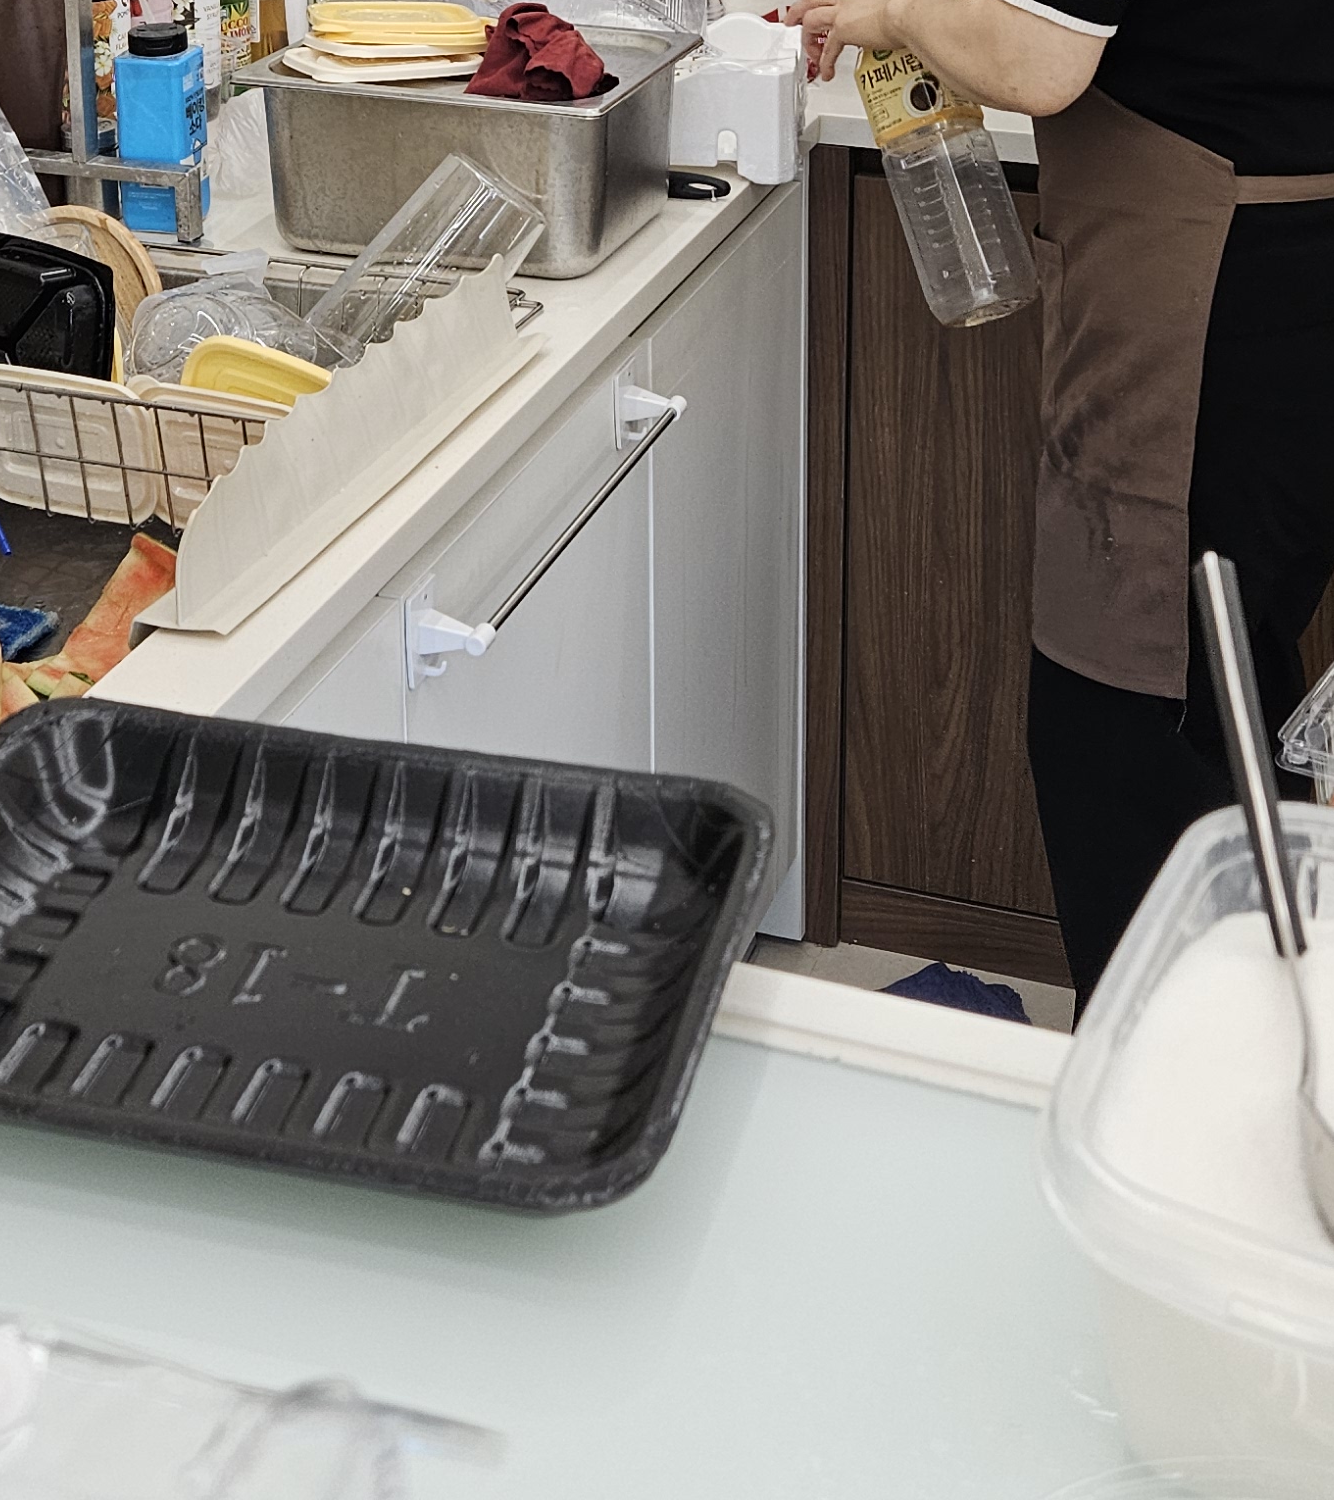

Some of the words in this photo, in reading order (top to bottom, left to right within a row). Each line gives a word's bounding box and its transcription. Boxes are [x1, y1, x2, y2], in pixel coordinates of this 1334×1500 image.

[859, 53, 924, 91] 카페시럽
[185, 98, 205, 119] 베이킹
[189, 115, 202, 136] 소다
